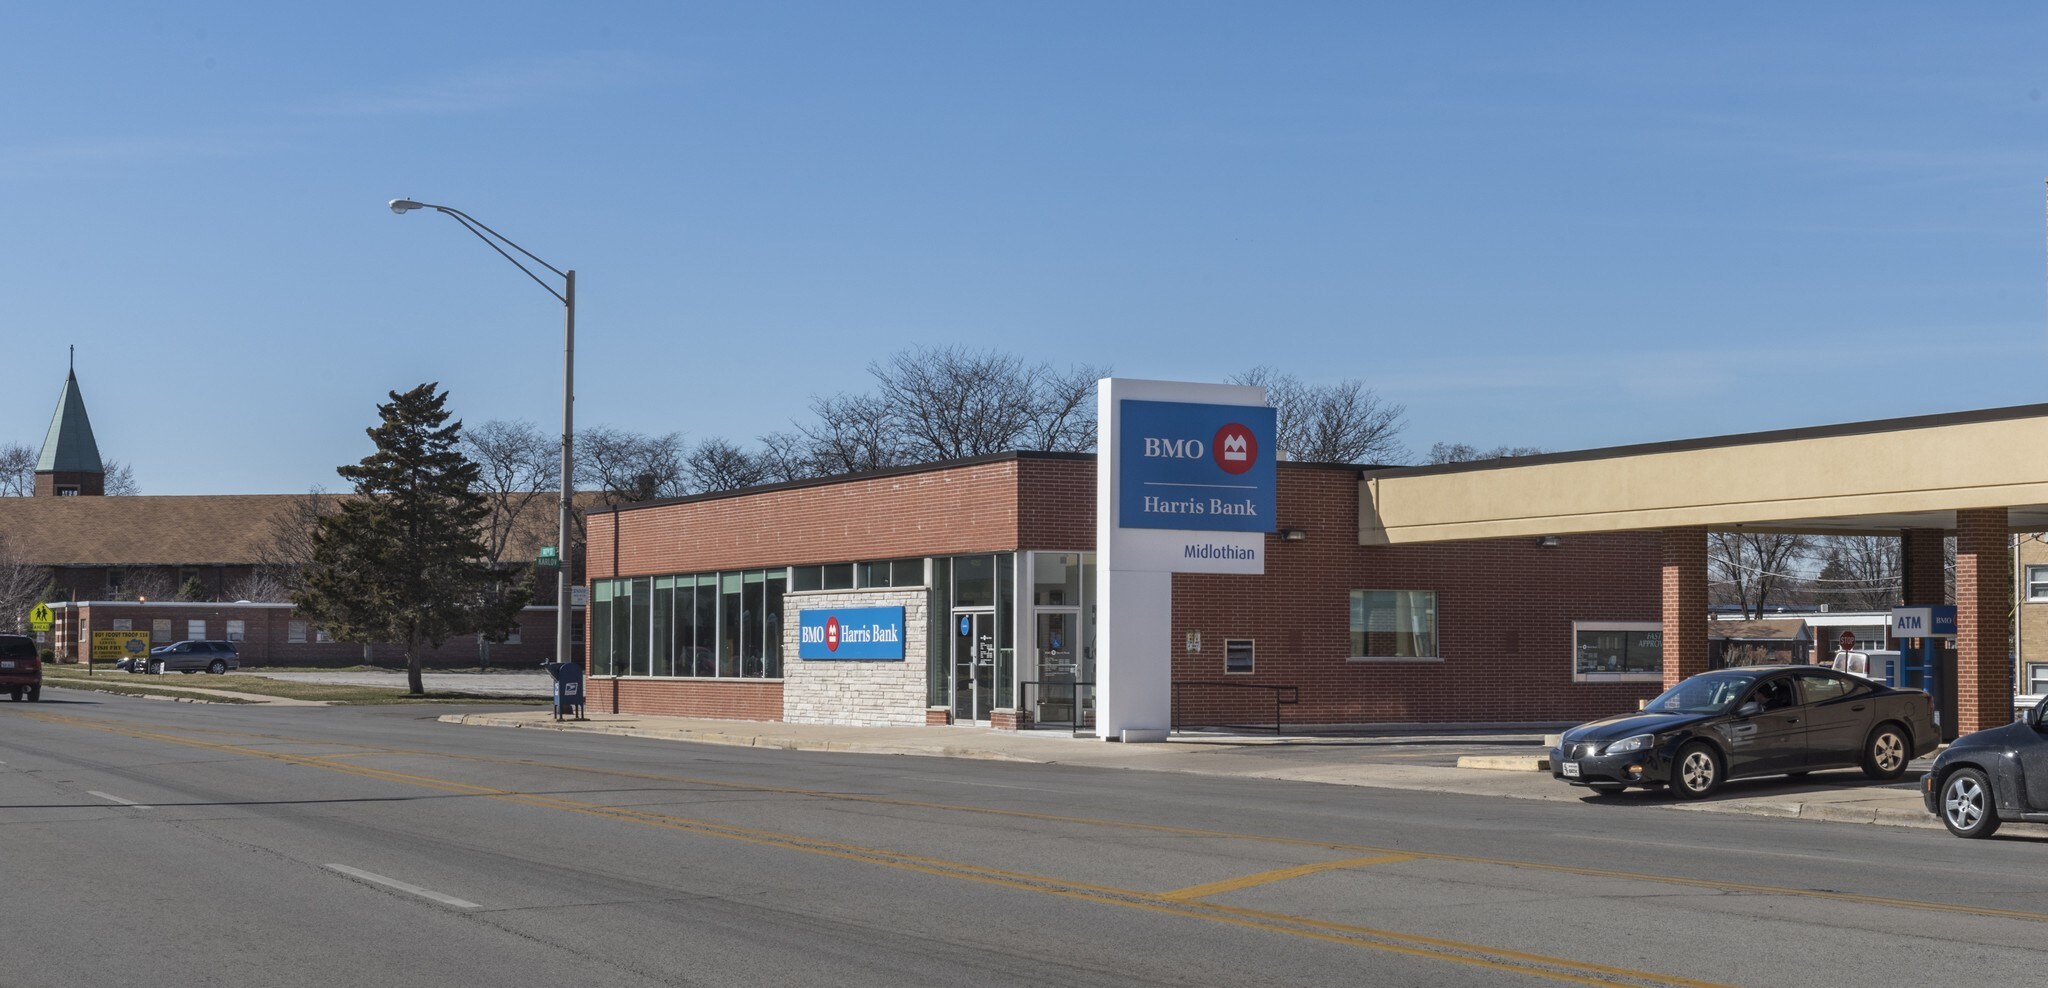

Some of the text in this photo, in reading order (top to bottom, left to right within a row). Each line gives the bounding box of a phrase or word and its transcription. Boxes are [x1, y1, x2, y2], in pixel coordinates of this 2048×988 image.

[1143, 437, 1204, 459] BMO
[1143, 496, 1258, 516] Harris Bank
[1184, 543, 1255, 560] Midlothian
[1897, 616, 1921, 629] ATM
[802, 624, 898, 643] BMO Harris Bank
[1840, 636, 1855, 645] STOP
